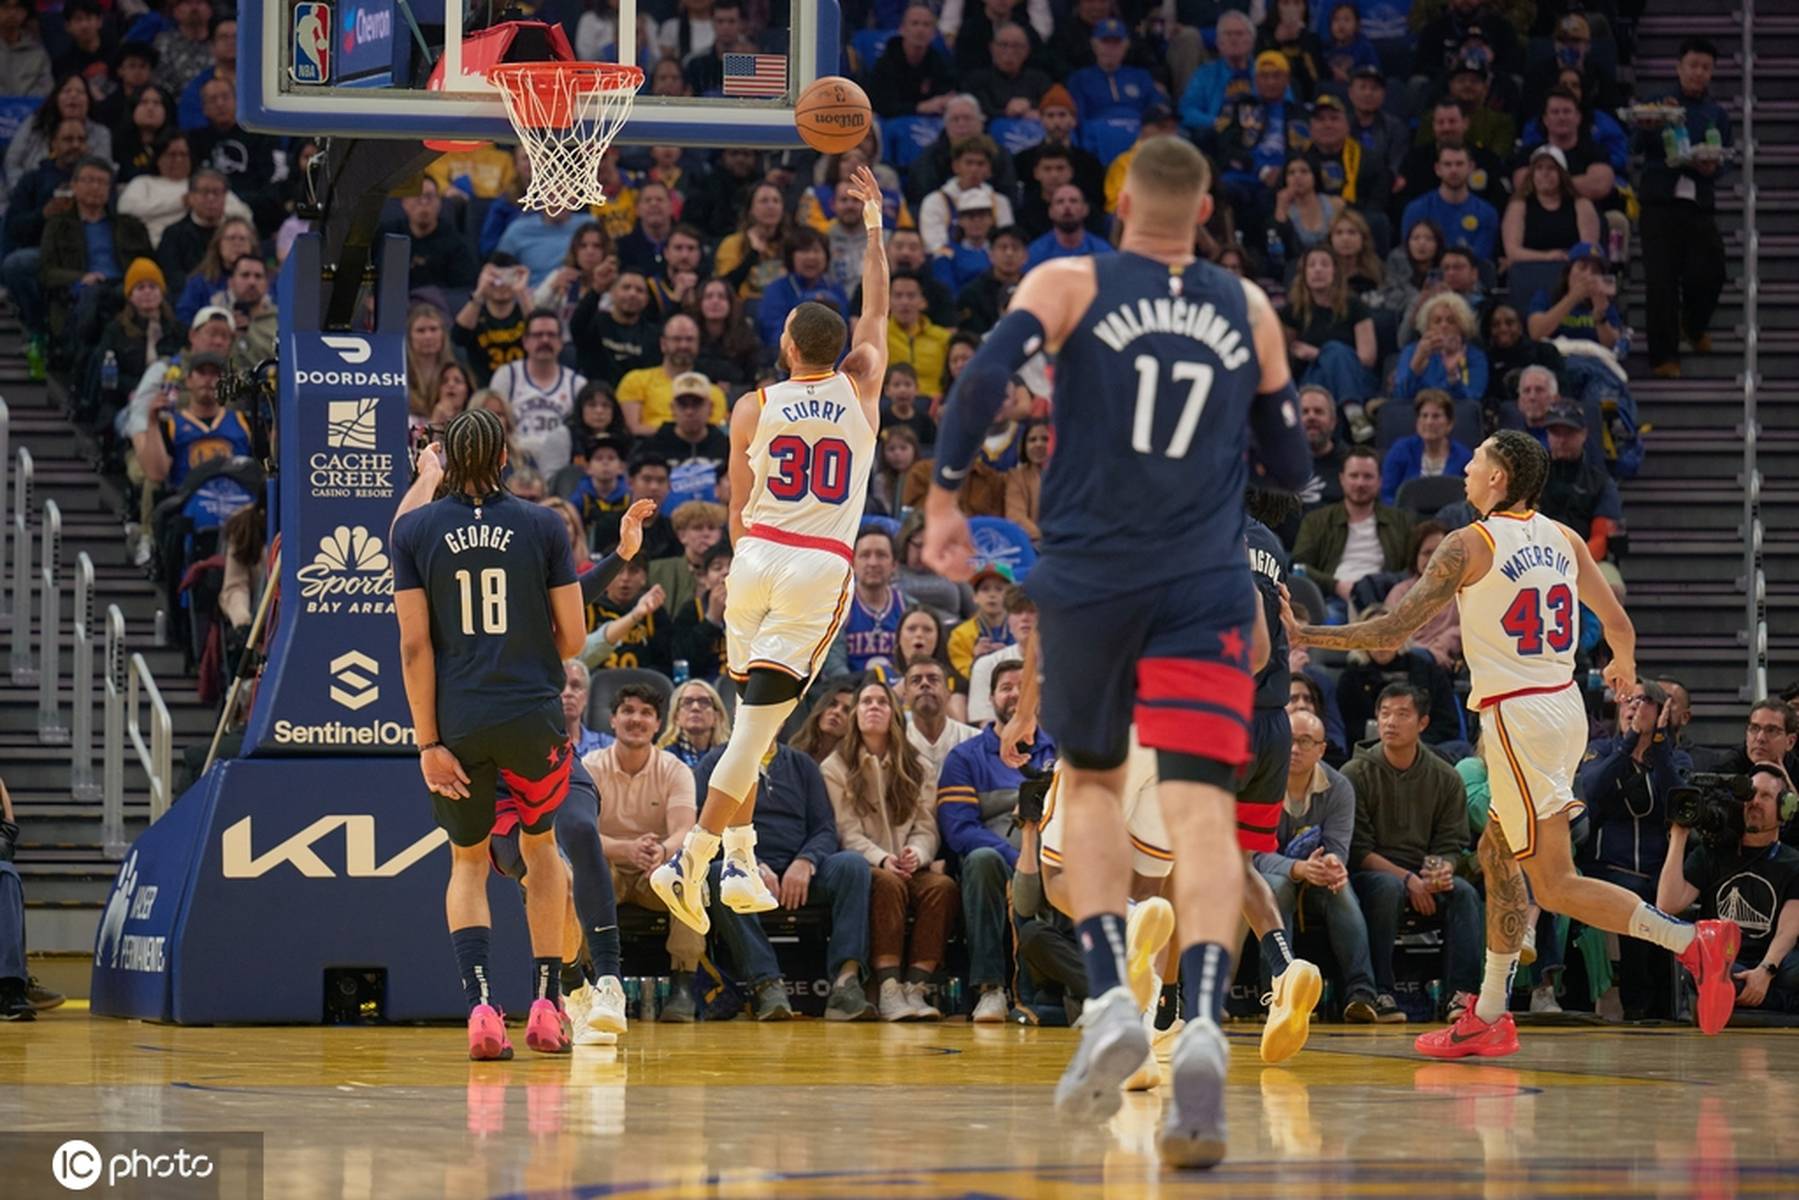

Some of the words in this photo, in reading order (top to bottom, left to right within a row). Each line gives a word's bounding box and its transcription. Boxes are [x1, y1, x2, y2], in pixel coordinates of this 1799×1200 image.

[356, 8, 390, 44] Chevron
[298, 64, 316, 77] NBA
[814, 112, 865, 128] Wilson
[295, 370, 407, 387] DOORDASH
[782, 399, 847, 424] CURRY
[1131, 354, 1214, 459] 17
[310, 452, 393, 470] CACHE
[767, 434, 853, 505] 30
[310, 470, 394, 488] CREEK
[311, 488, 351, 498] CASINO
[355, 489, 394, 498] RESORT
[444, 524, 515, 555] GEORGE
[1500, 545, 1553, 583] WATERS
[1555, 552, 1571, 577] III
[297, 562, 395, 602] Sports
[306, 602, 341, 614] BAY
[348, 602, 396, 614] AREA
[455, 568, 508, 635] 18
[1500, 583, 1573, 655] 43
[846, 631, 897, 655] SIXE
[274, 720, 418, 746] SentinelOn
